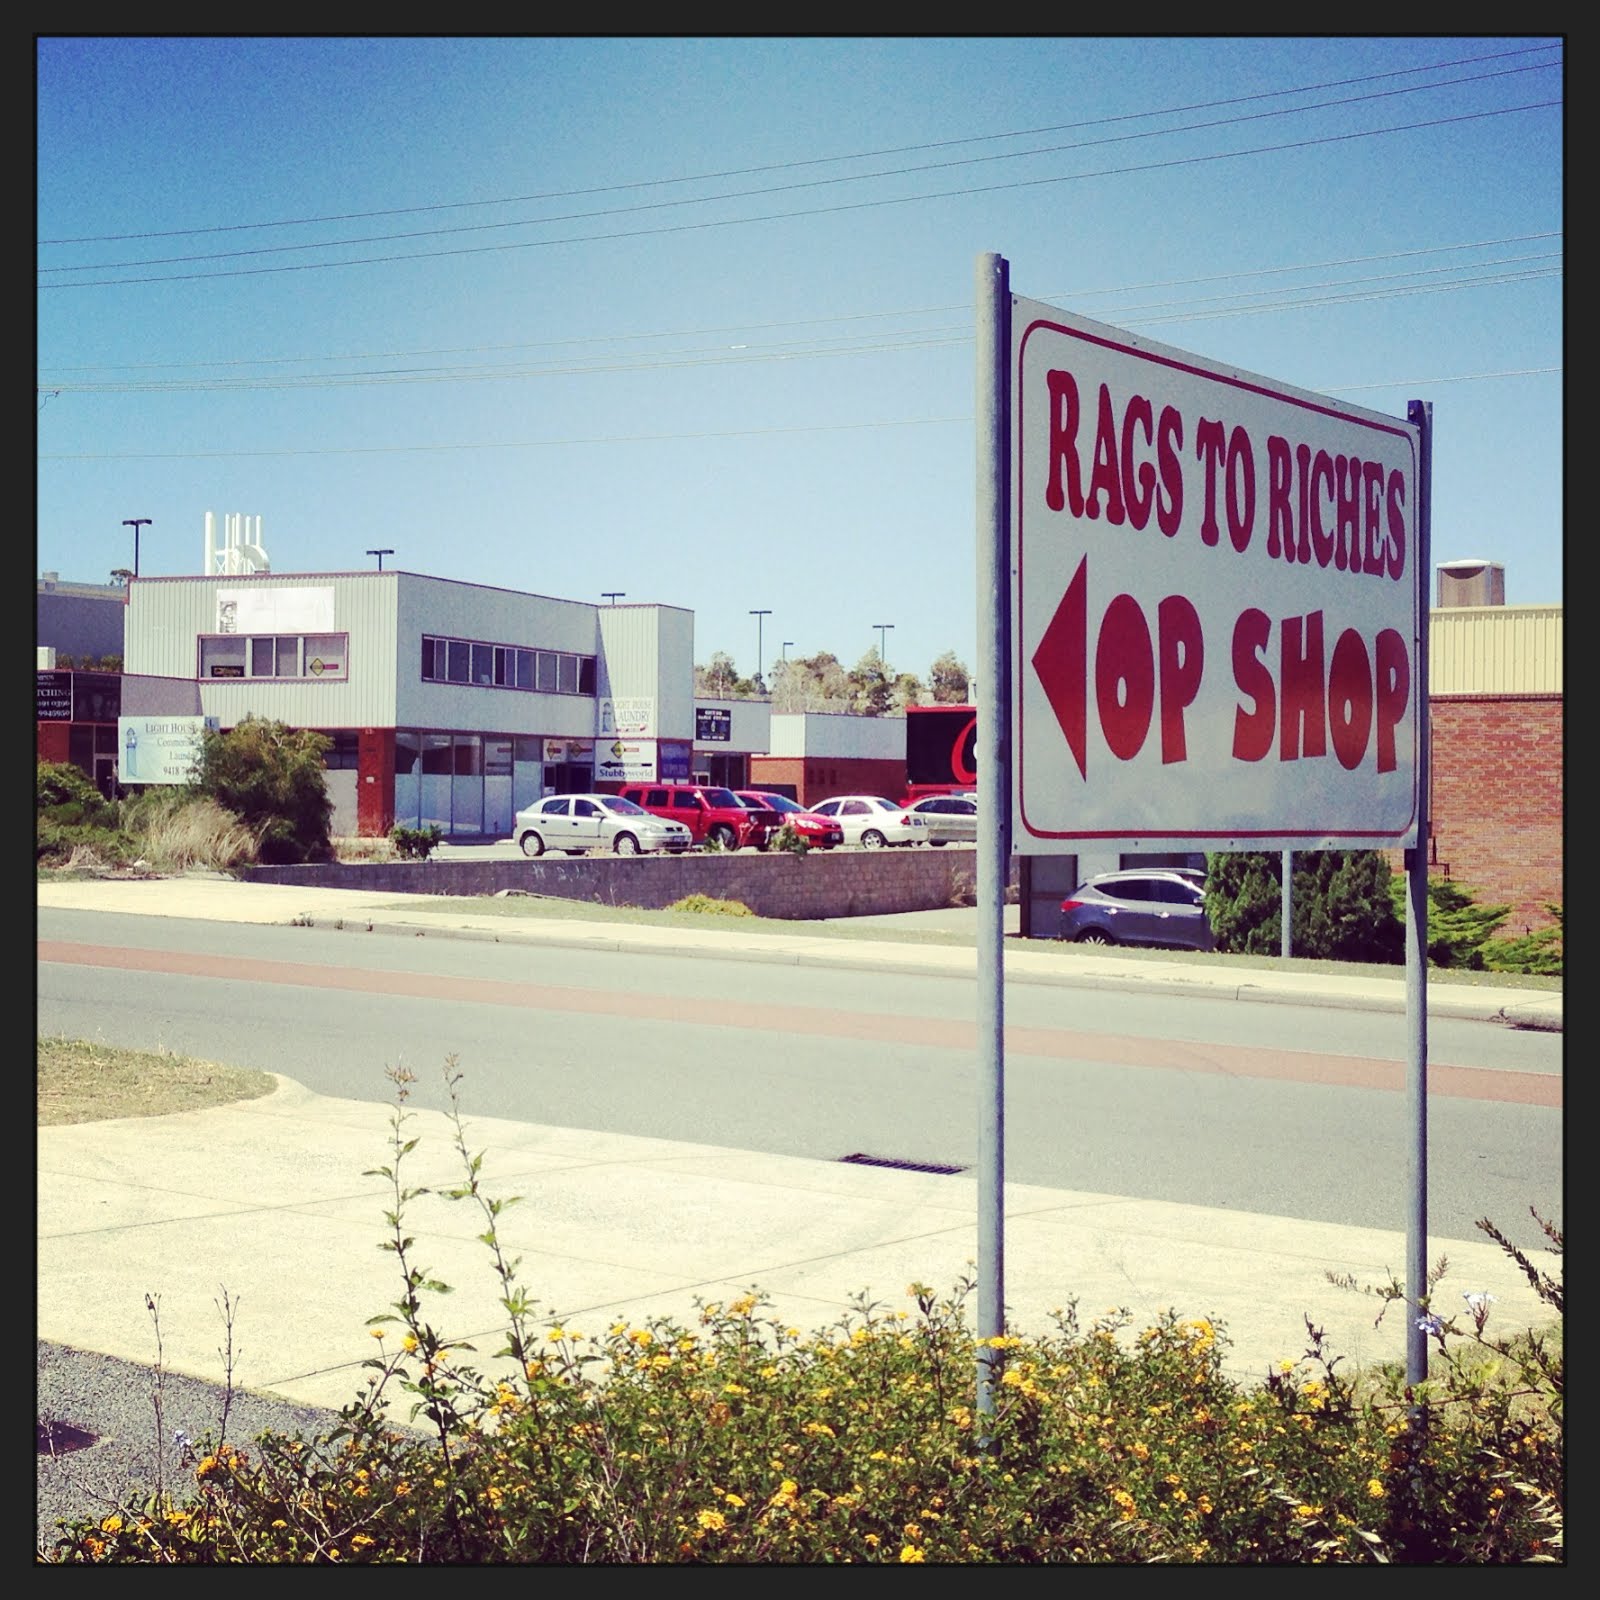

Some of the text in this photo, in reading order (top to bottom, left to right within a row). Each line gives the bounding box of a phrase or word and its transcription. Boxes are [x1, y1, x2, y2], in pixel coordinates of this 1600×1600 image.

[1046, 369, 1406, 581] RAGS TO RICHES
[1096, 593, 1410, 774] OP SHOP
